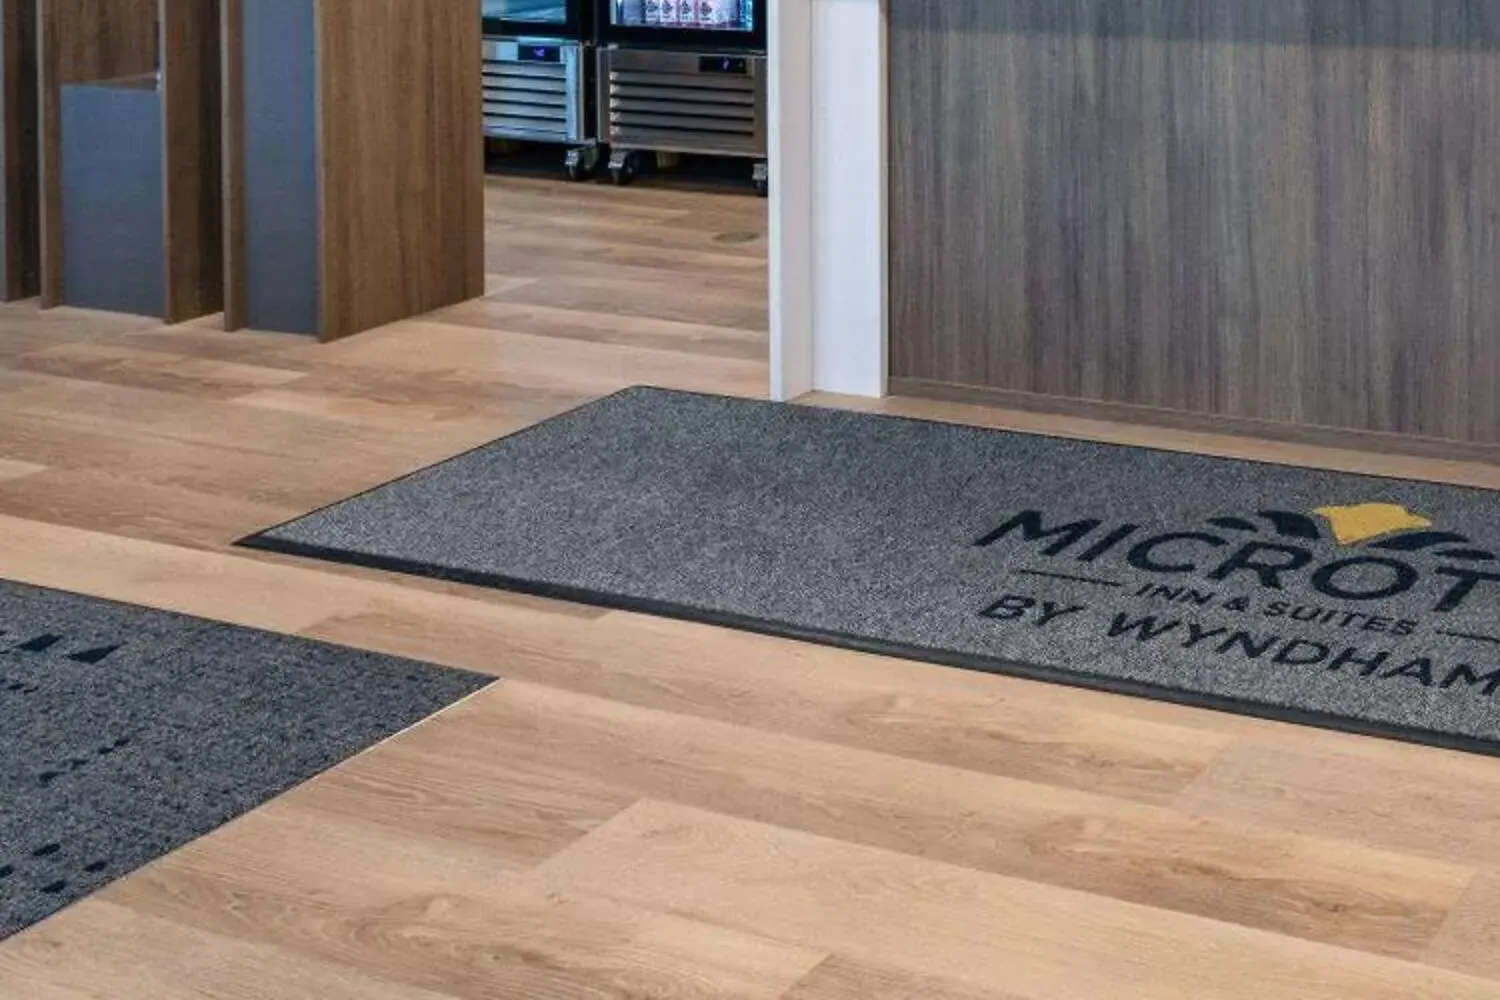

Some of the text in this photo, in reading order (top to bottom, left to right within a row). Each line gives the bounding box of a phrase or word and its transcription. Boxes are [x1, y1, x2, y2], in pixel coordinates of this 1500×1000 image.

[977, 595, 1084, 627] BY
[1134, 583, 1419, 636] INN & SUITES
